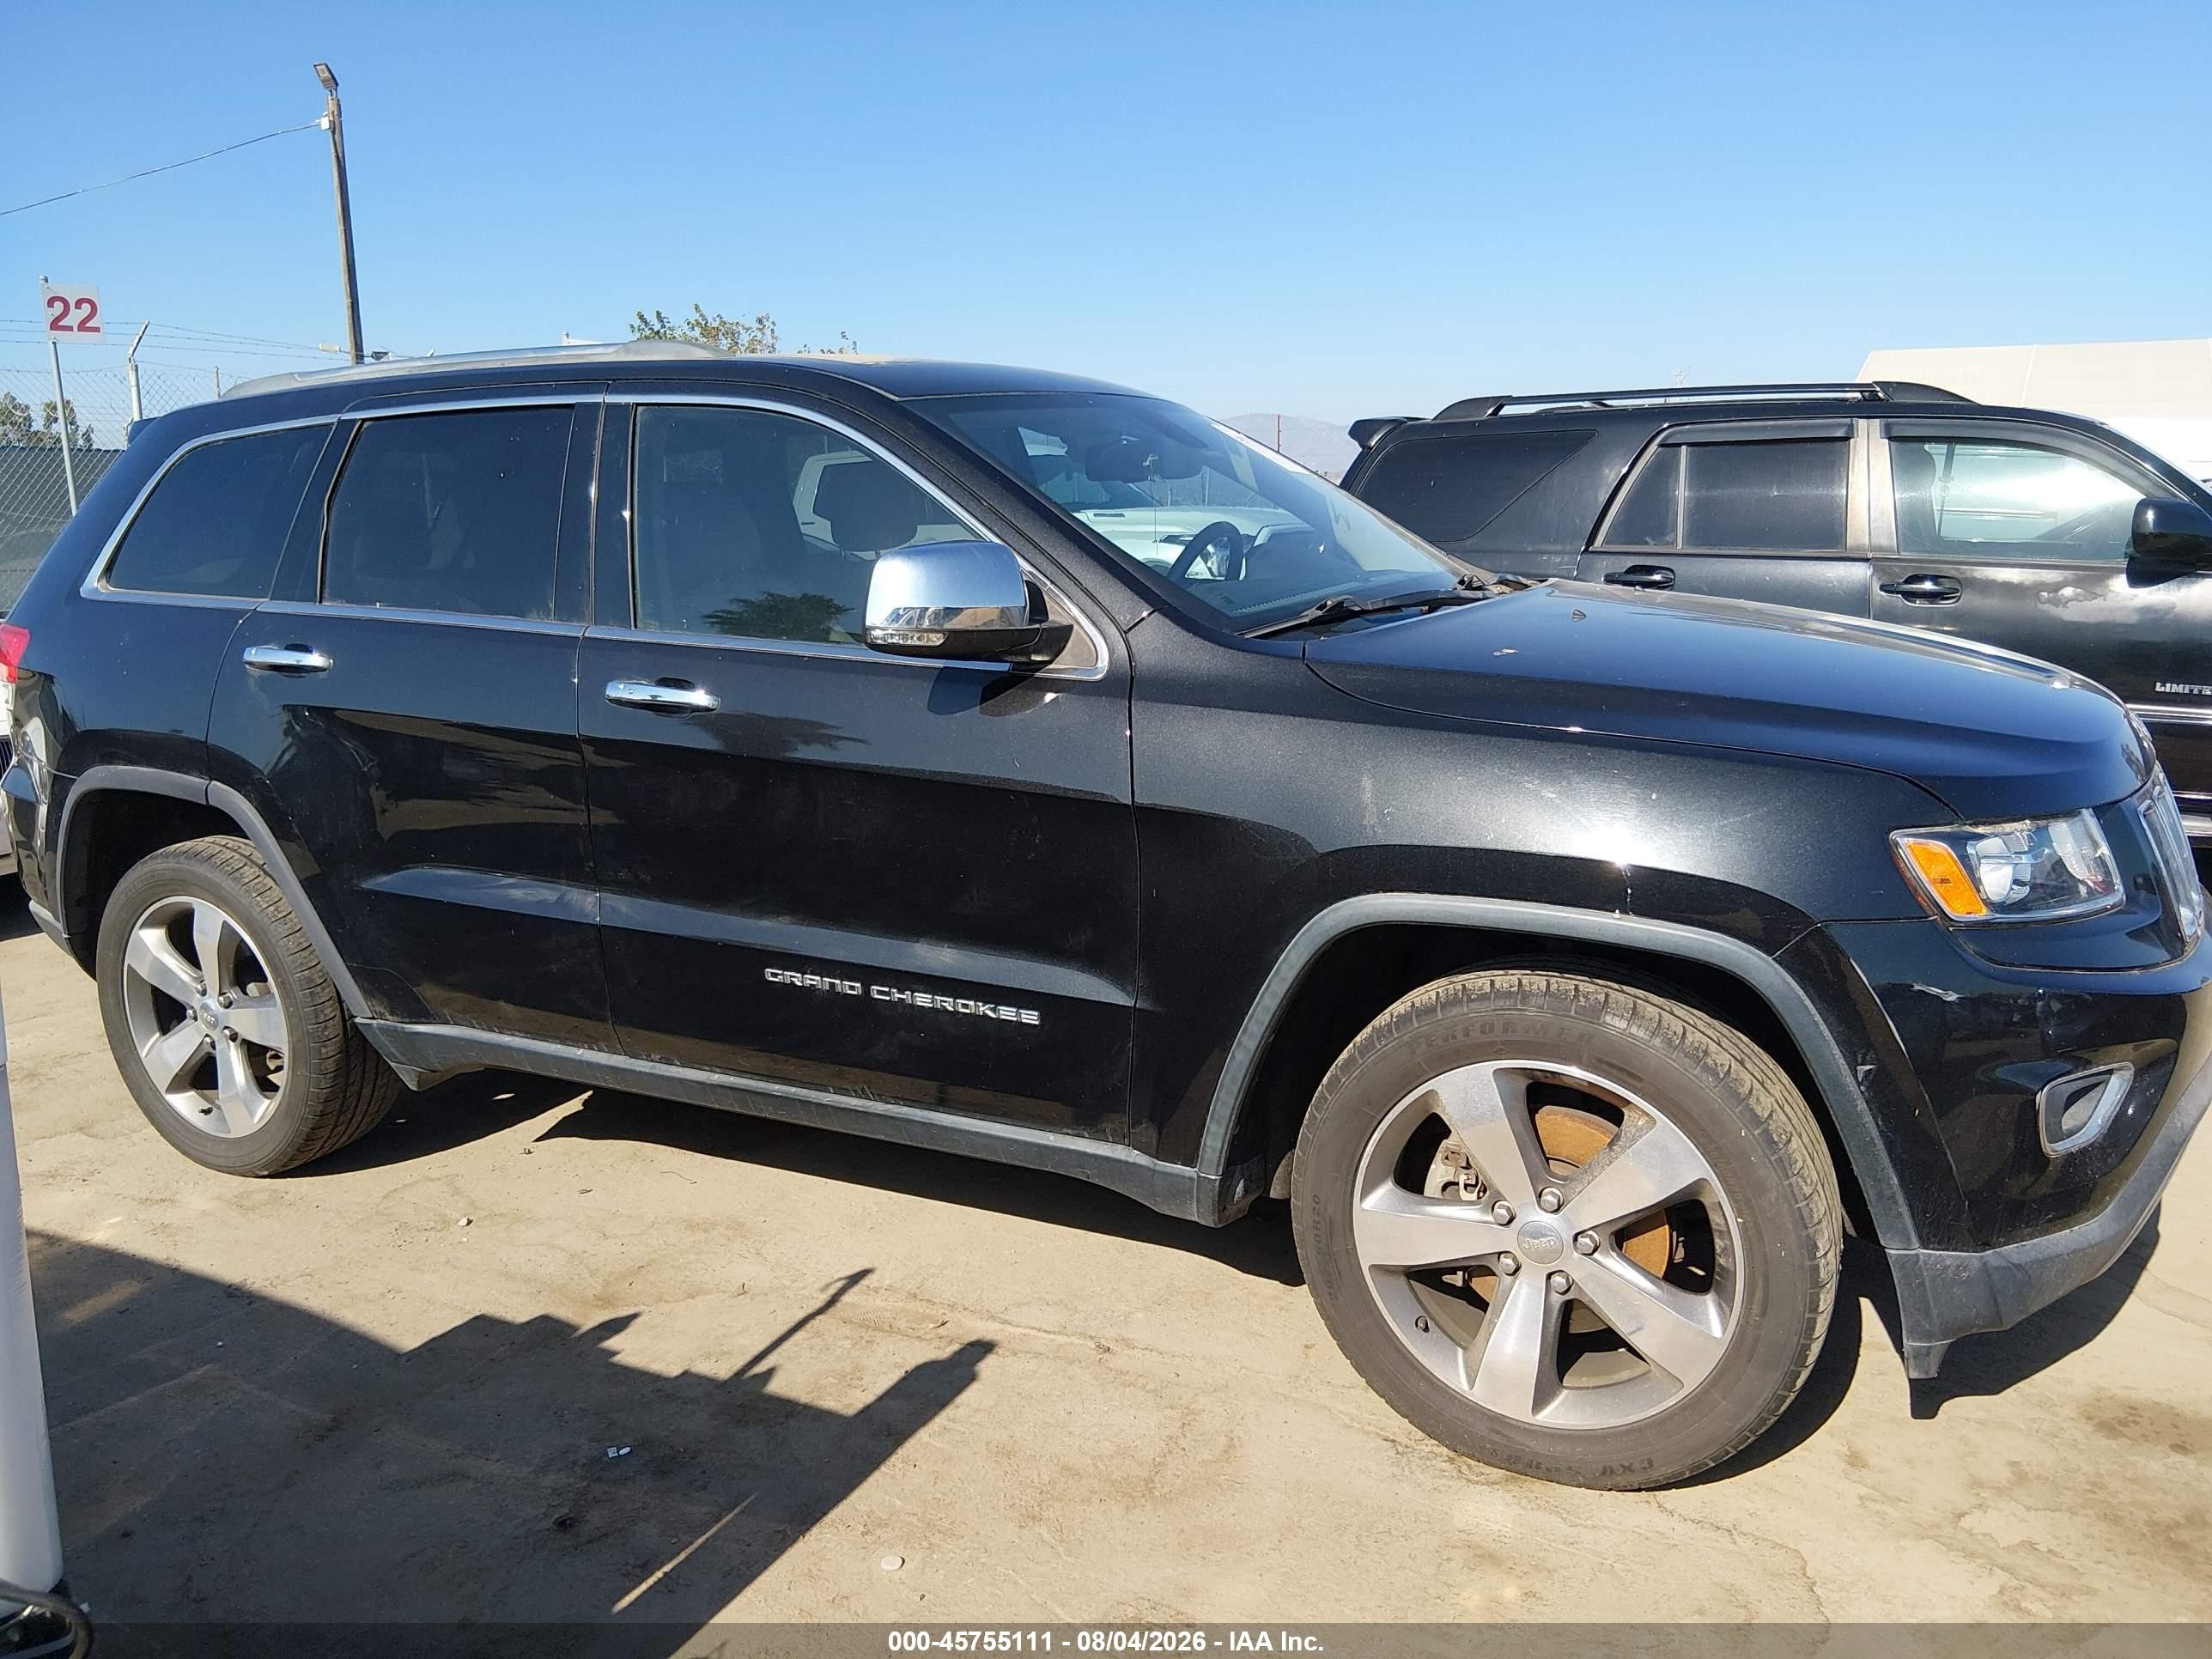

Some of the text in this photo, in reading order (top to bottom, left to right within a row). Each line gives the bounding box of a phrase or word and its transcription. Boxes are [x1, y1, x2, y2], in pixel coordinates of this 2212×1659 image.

[46, 295, 101, 333] 22
[763, 967, 1042, 1026] GRAND CHEROKEE
[1410, 1019, 1595, 1054] PERFORMER
[1522, 1236, 1558, 1250] Jeep
